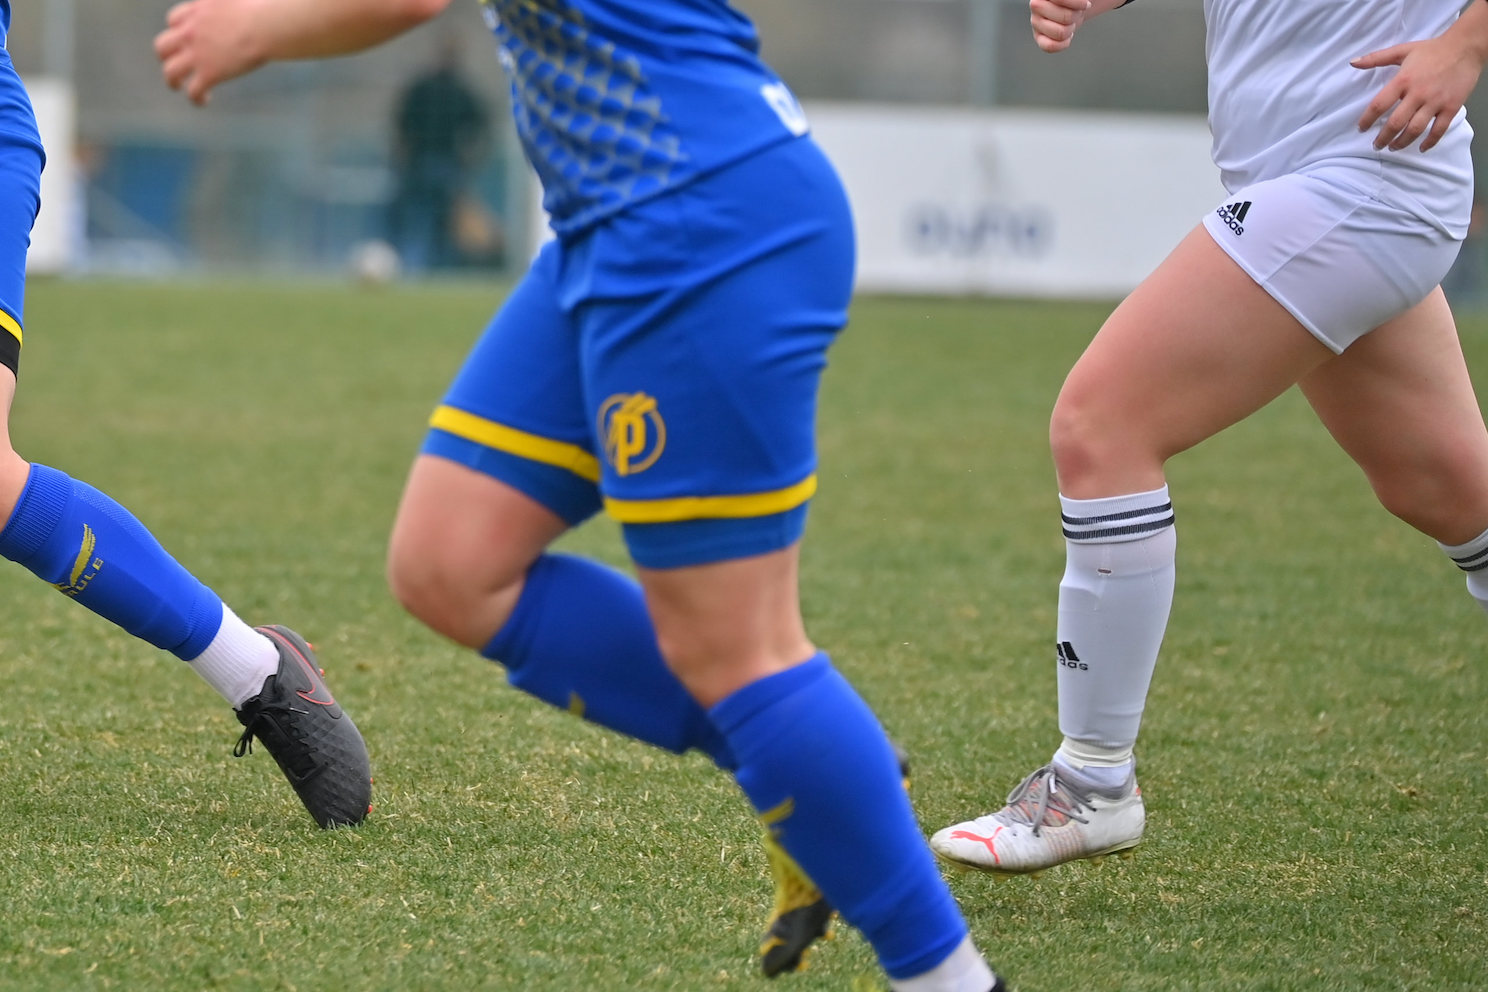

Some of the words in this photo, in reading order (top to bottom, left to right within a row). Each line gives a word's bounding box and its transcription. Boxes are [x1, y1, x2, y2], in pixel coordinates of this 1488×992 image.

[1216, 206, 1245, 236] adidas
[67, 557, 104, 596] RULE
[1058, 657, 1089, 671] das
